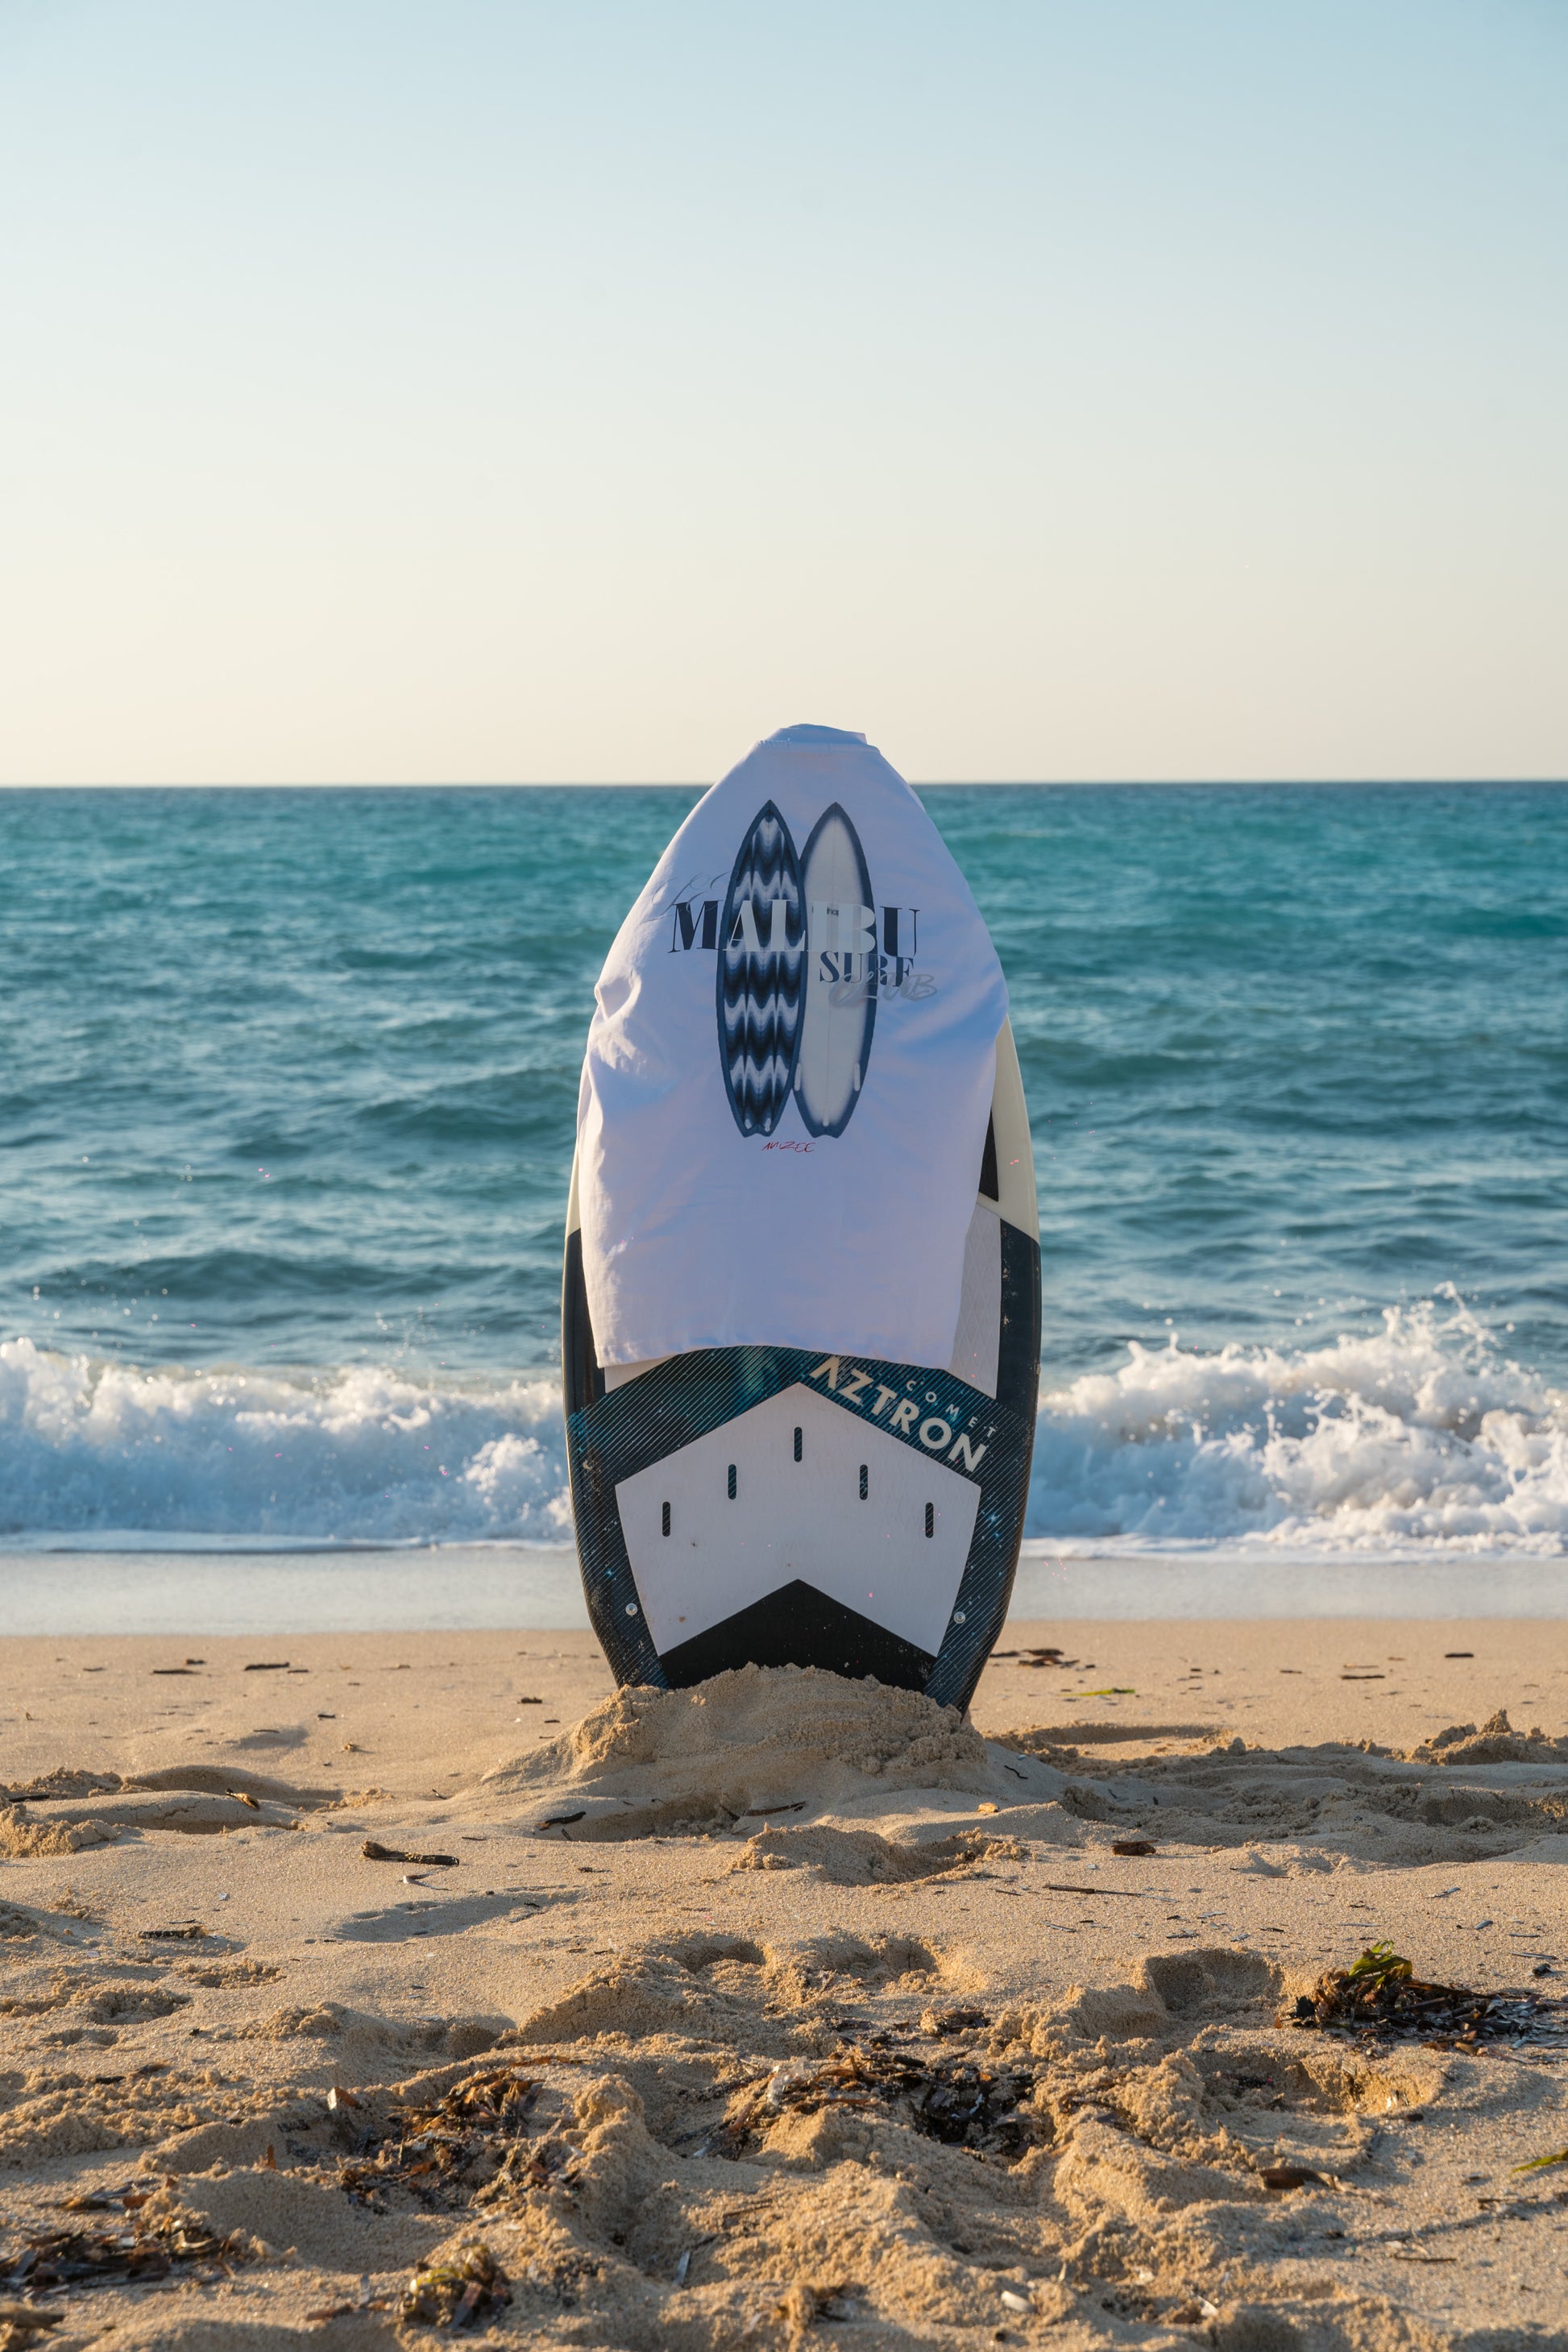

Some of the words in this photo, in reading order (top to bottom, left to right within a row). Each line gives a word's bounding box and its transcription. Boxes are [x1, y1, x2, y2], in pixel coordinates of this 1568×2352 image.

[667, 899, 920, 957] MALIBU
[819, 951, 915, 987] SURF
[809, 1356, 988, 1473] AZTRON
[906, 1379, 997, 1437] COMET
